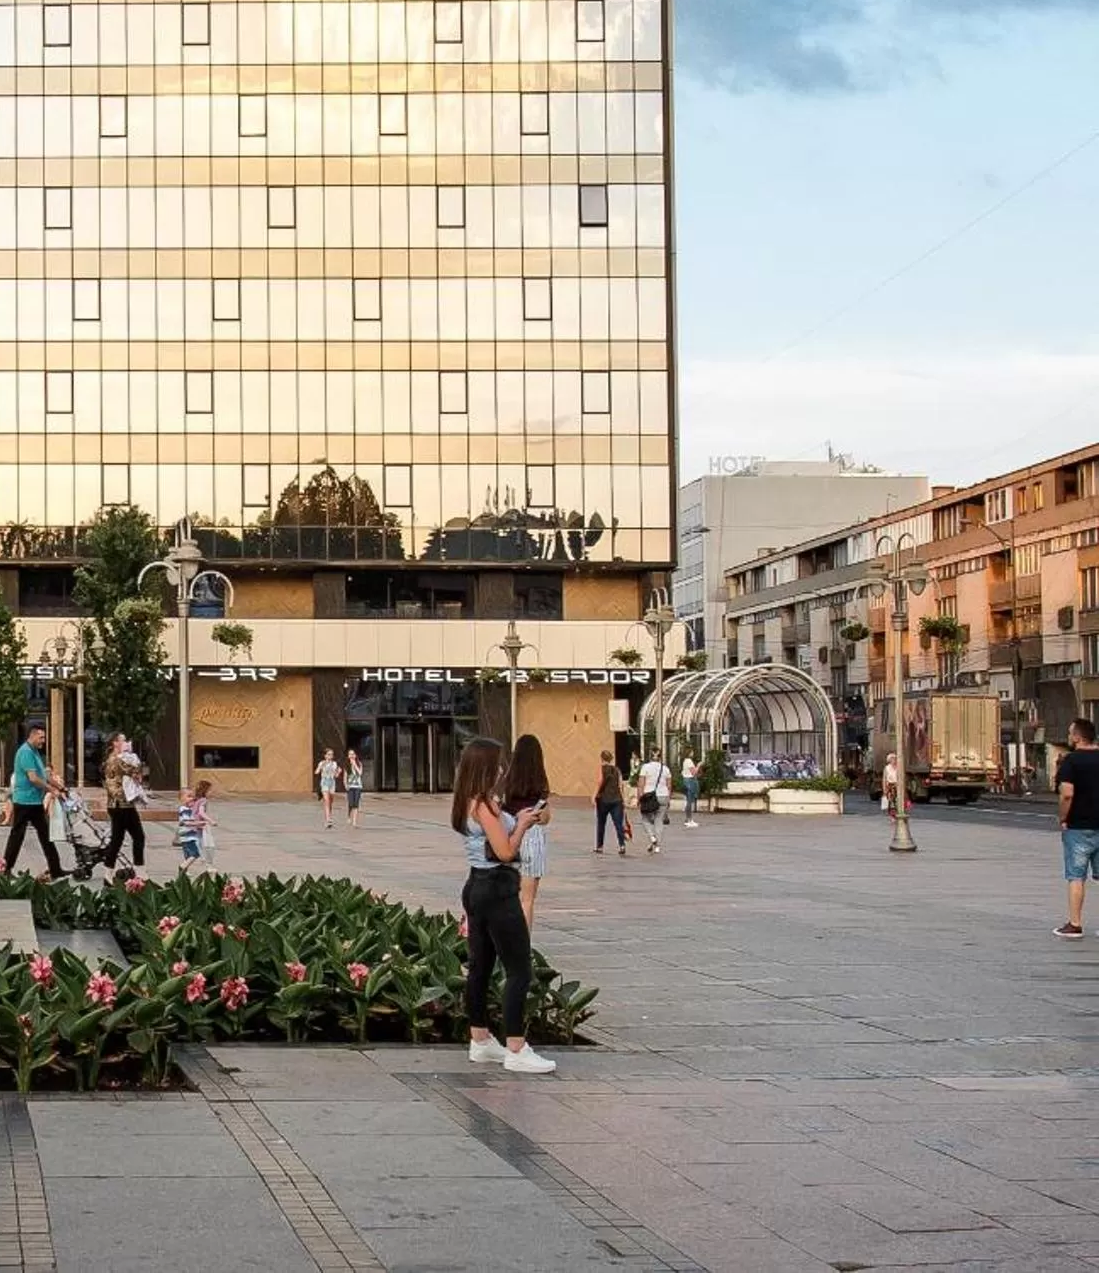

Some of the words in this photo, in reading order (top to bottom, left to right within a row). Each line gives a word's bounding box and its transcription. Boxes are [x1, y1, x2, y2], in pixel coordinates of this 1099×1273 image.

[709, 455, 767, 474] HOTE
[220, 667, 279, 681] BAR
[362, 668, 464, 683] HOTEL
